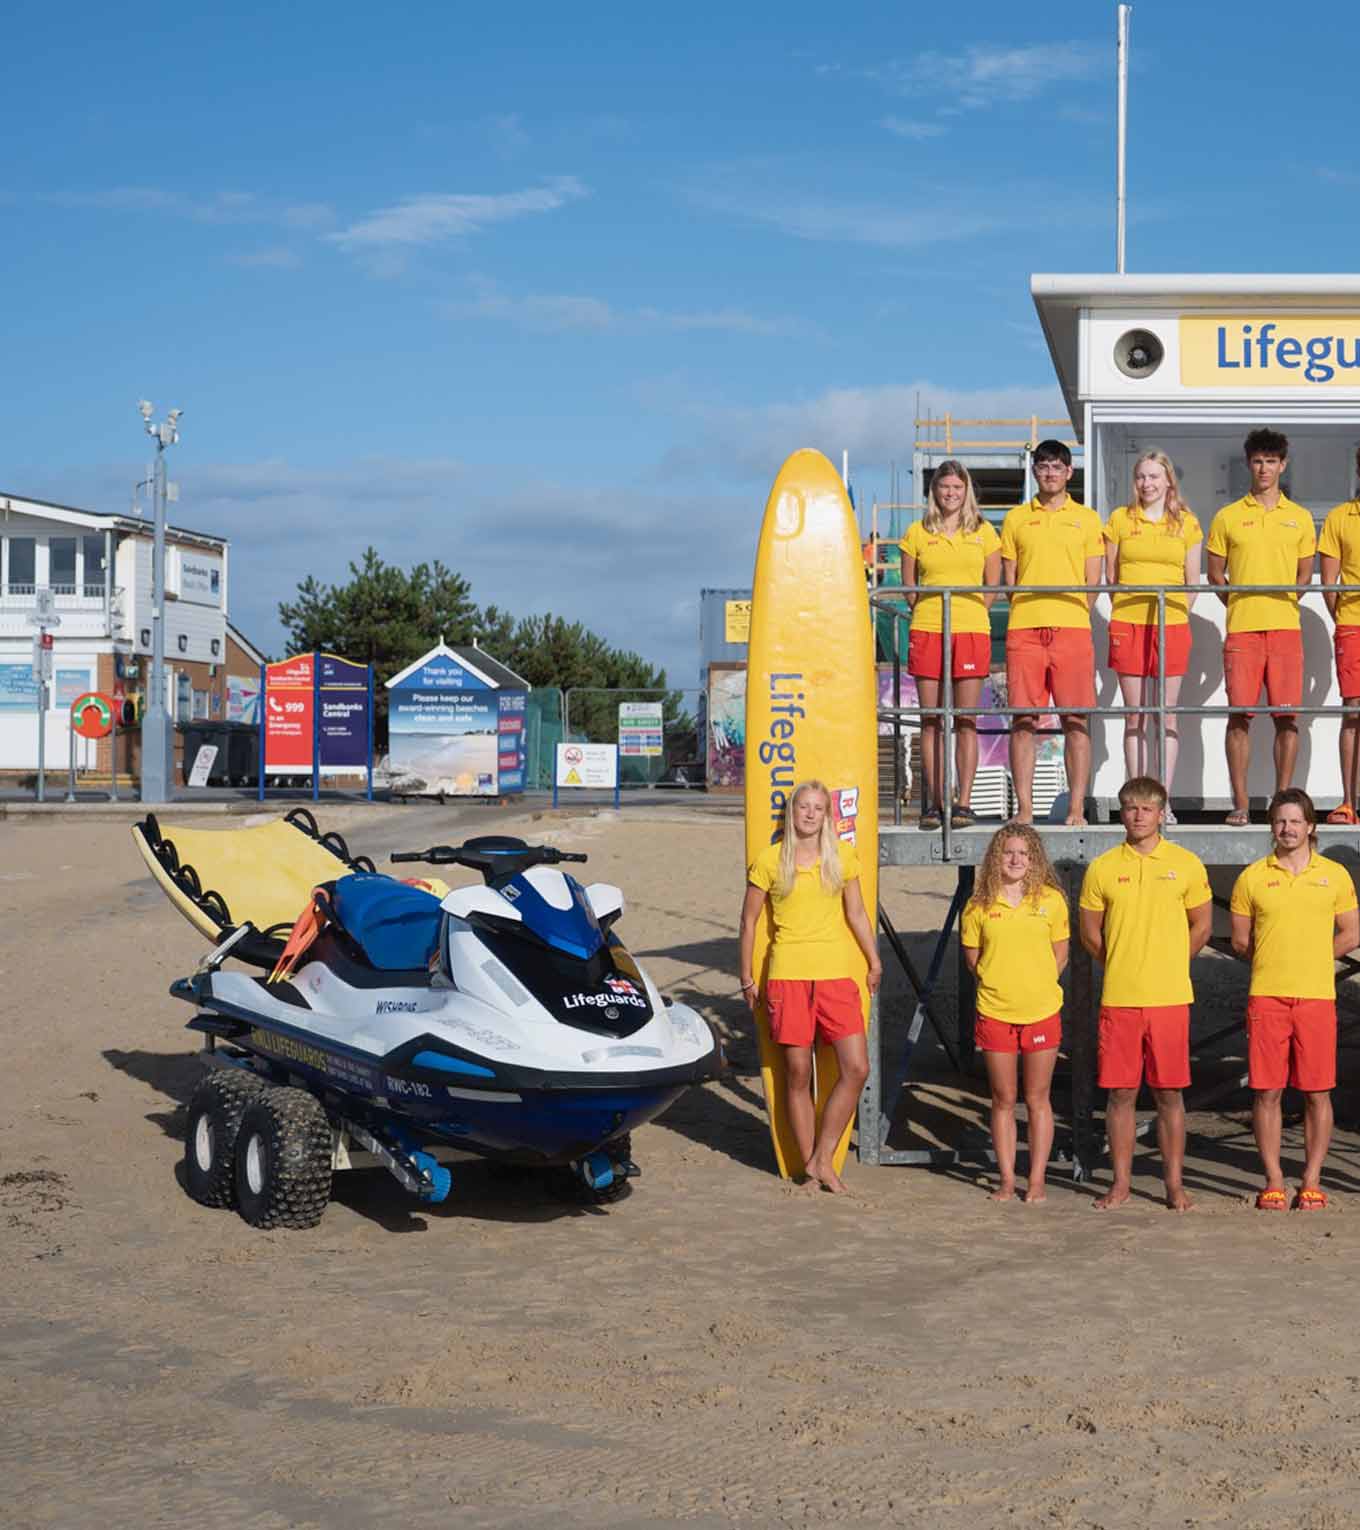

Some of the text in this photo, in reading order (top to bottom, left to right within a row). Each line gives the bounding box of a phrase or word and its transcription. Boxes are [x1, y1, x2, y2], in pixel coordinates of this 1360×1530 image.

[423, 667, 463, 677] Thank you
[412, 694, 438, 702] Please
[439, 694, 459, 704] keep
[285, 702, 305, 713] 999
[323, 703, 363, 711] Sandbanks
[398, 704, 455, 714] award-winning
[562, 991, 648, 1009] Lifeguards
[272, 1032, 328, 1073] LIFEGUARDS
